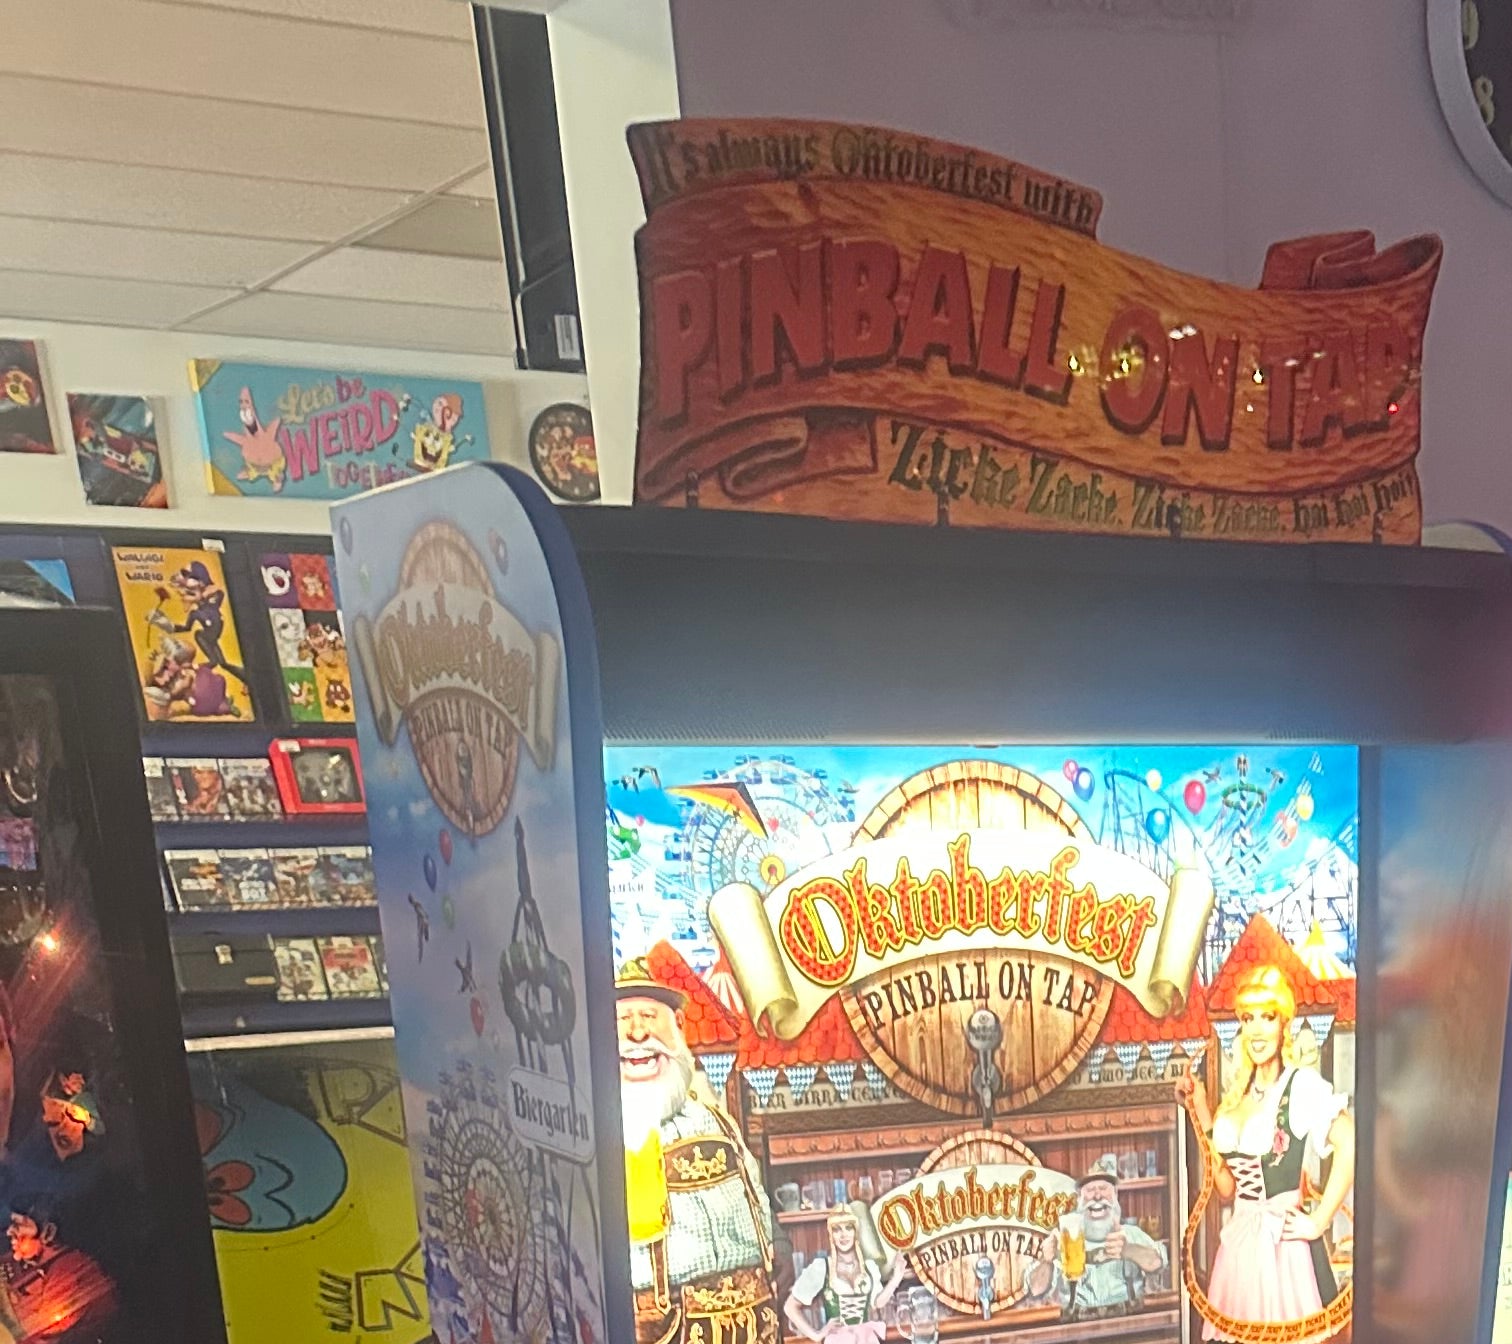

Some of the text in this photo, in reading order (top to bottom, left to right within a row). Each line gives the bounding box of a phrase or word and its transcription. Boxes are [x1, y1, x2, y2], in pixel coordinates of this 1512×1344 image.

[705, 129, 822, 181] always
[831, 125, 1018, 201] Oktoberfest
[1022, 177, 1096, 226] with
[651, 236, 1419, 451] PINBALL ON TAP
[335, 375, 367, 402] be
[280, 388, 401, 482] WEIRD
[125, 571, 164, 583] WARIO
[779, 831, 1161, 987] Oktoberfest
[864, 960, 1098, 1031] PINBALL ON TAP
[510, 1080, 591, 1143] Biergarten
[921, 1232, 989, 1271] PINBALL
[992, 1231, 1012, 1253] ON
